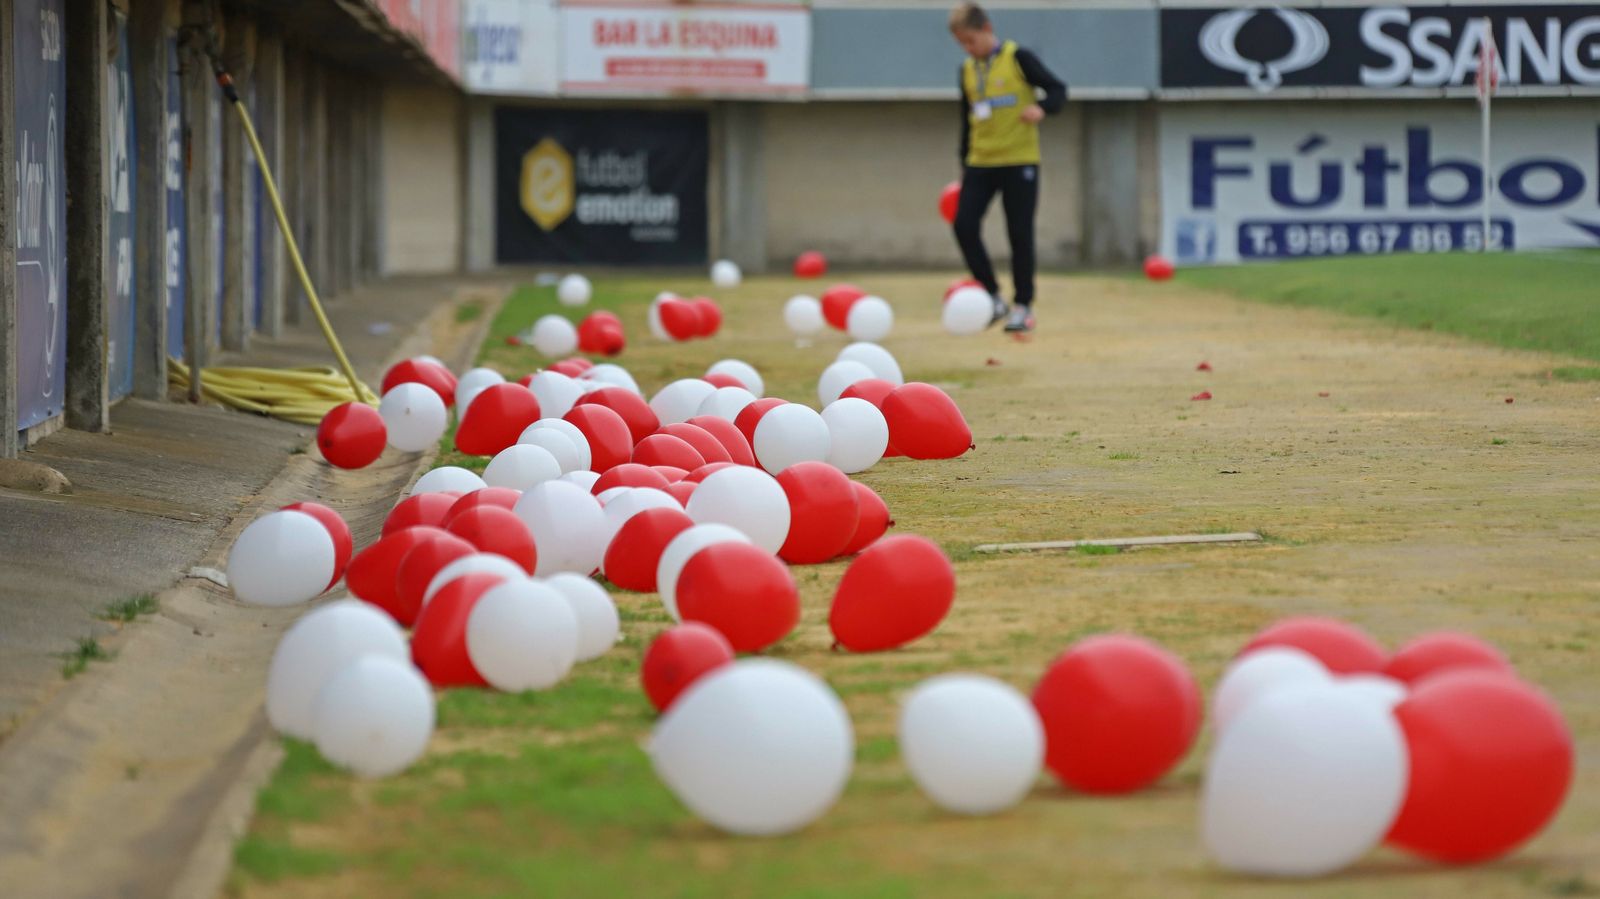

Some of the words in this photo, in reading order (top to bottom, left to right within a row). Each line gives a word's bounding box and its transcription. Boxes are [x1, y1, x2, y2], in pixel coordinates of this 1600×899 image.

[593, 19, 636, 47] BAR
[645, 21, 671, 47] LA
[677, 21, 778, 52] ESQUINA
[1359, 8, 1600, 88] SSANG
[1190, 125, 1600, 210] Fútbo
[576, 187, 680, 225] emotion
[1247, 224, 1277, 253] T.
[1358, 224, 1400, 254] 67
[1463, 223, 1504, 252] 52
